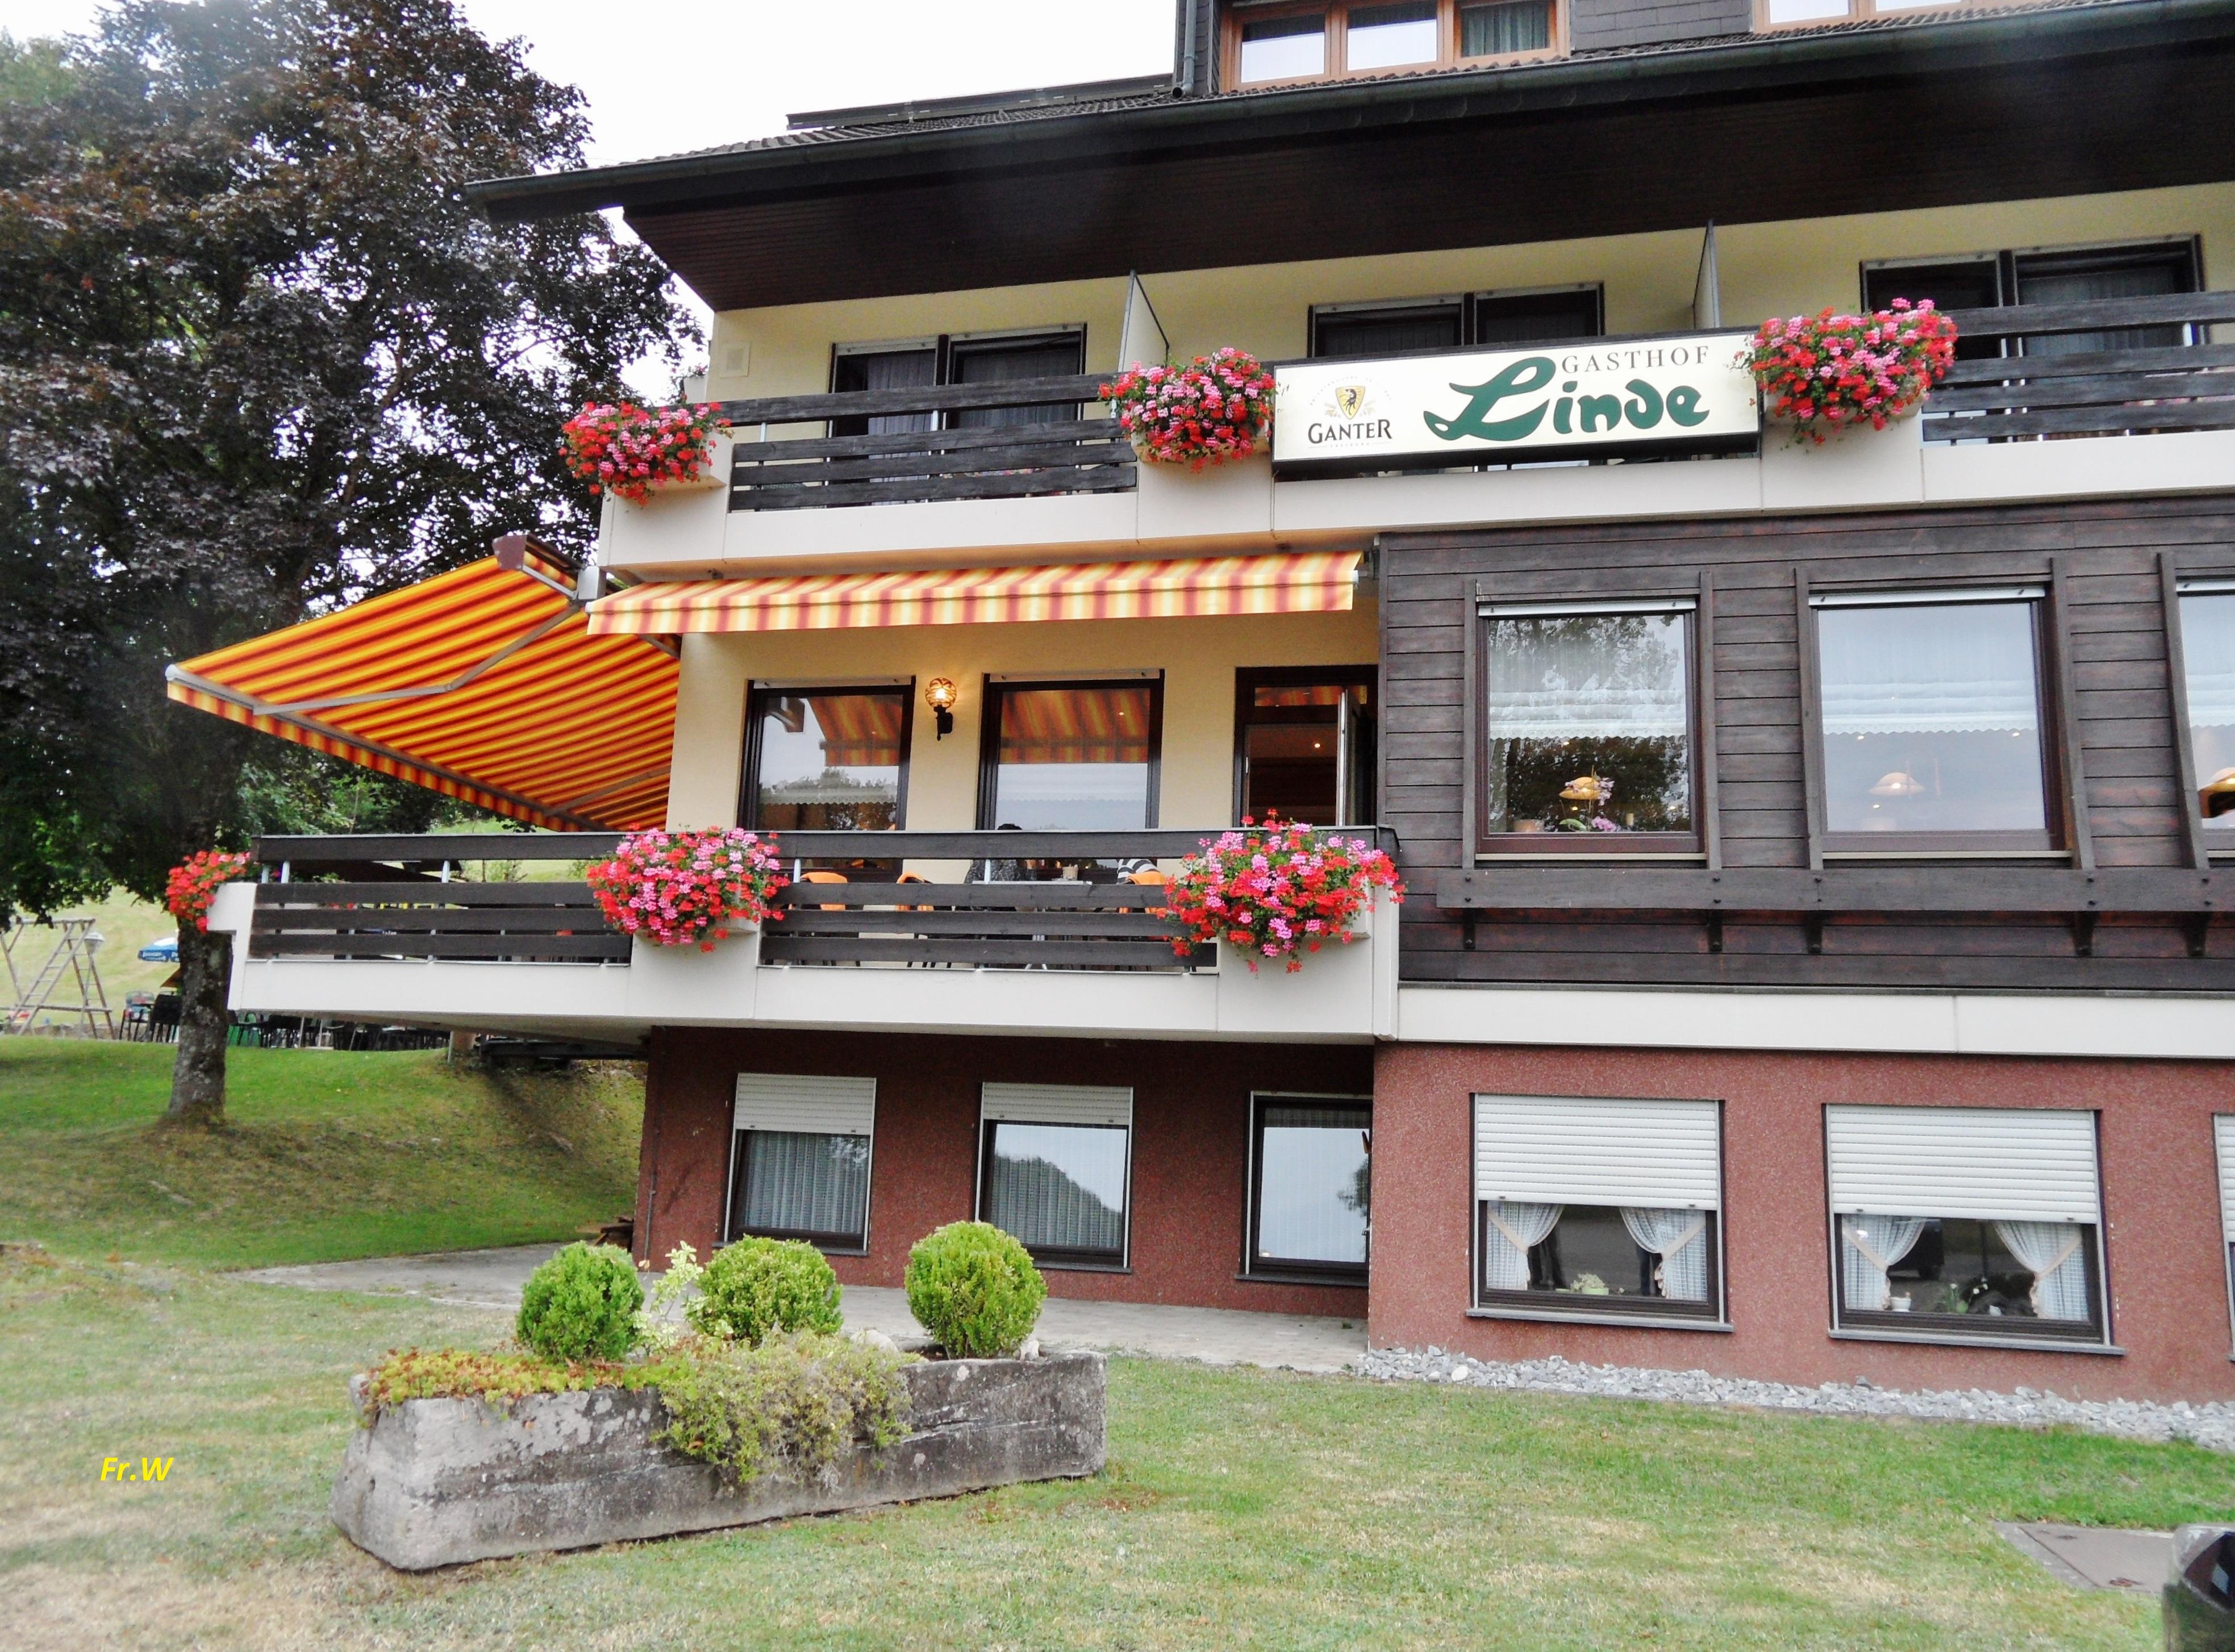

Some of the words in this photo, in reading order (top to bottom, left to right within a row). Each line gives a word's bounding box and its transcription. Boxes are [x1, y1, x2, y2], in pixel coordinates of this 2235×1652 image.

[1561, 345, 1709, 374] GASTHOF
[1423, 356, 1710, 442] Linde
[1308, 419, 1392, 444] GANTER
